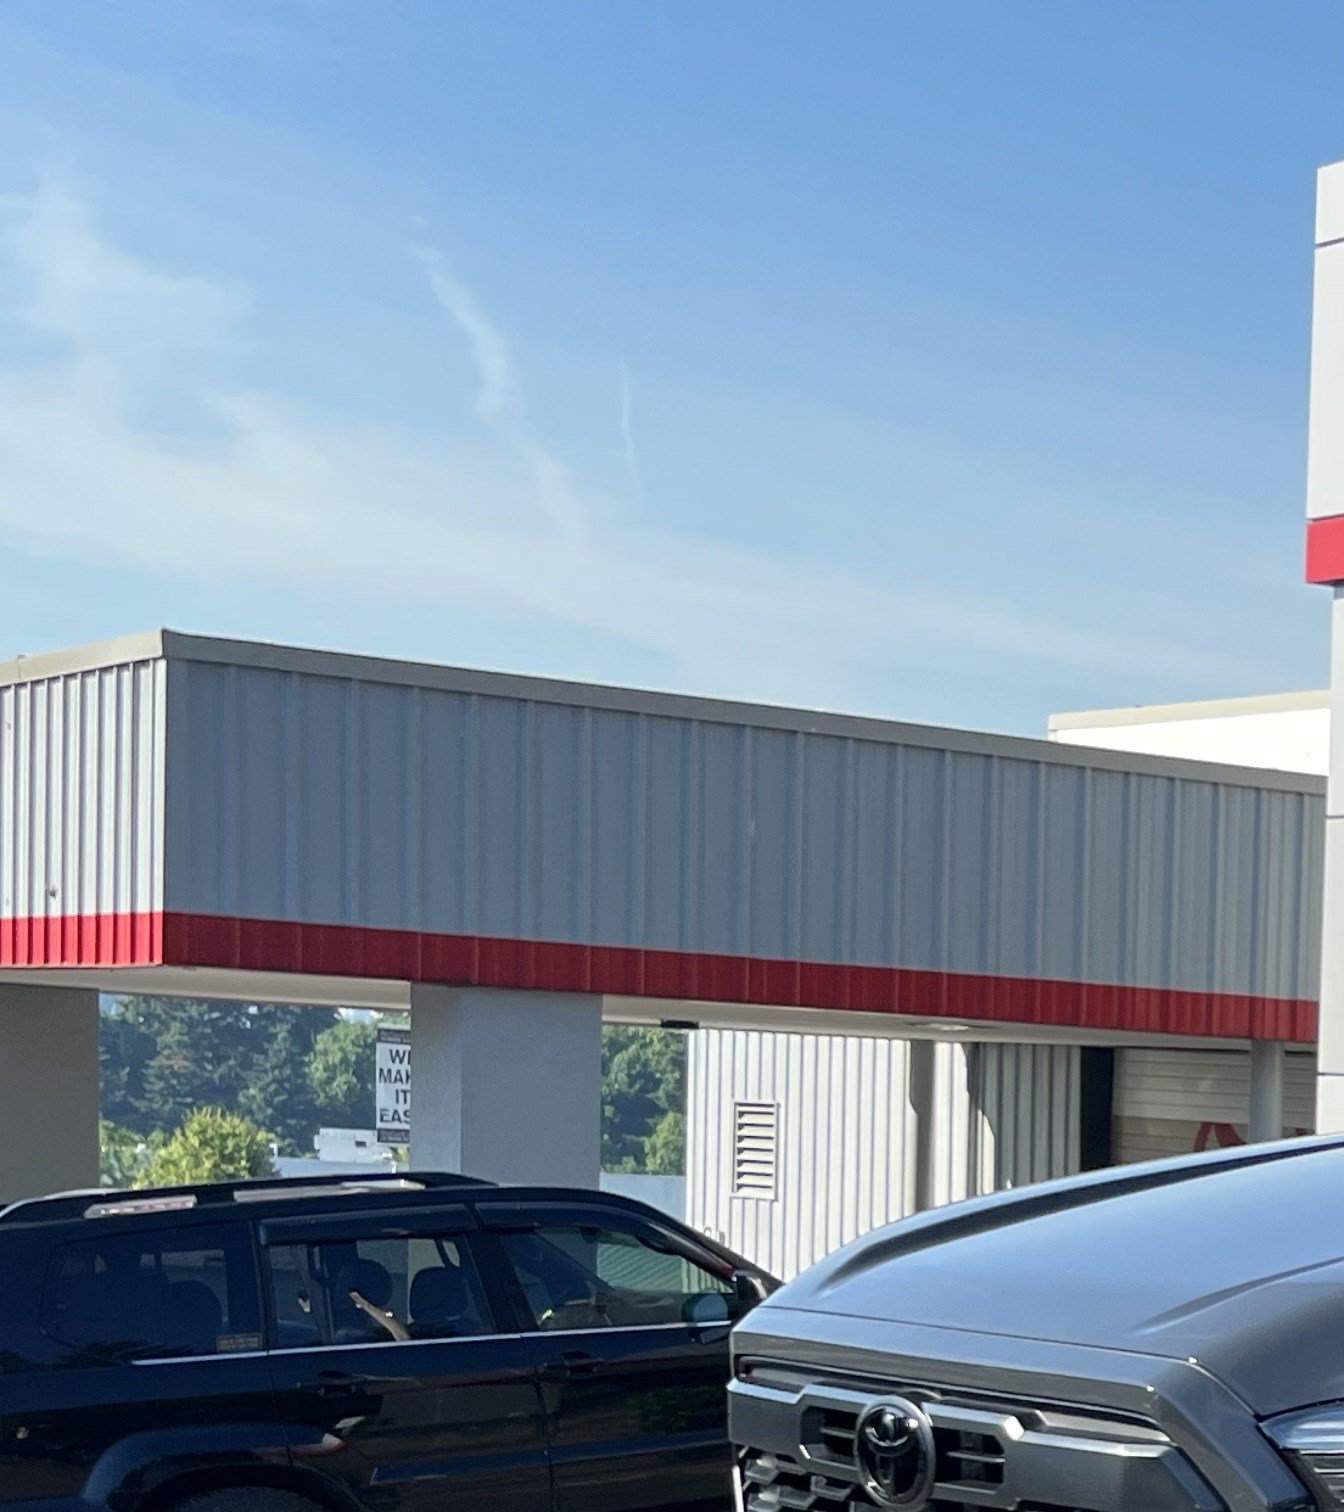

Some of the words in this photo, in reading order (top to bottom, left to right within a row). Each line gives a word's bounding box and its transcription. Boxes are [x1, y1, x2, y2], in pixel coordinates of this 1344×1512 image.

[388, 1049, 411, 1065] W
[379, 1067, 411, 1084] MA
[379, 1107, 411, 1126] EAS
